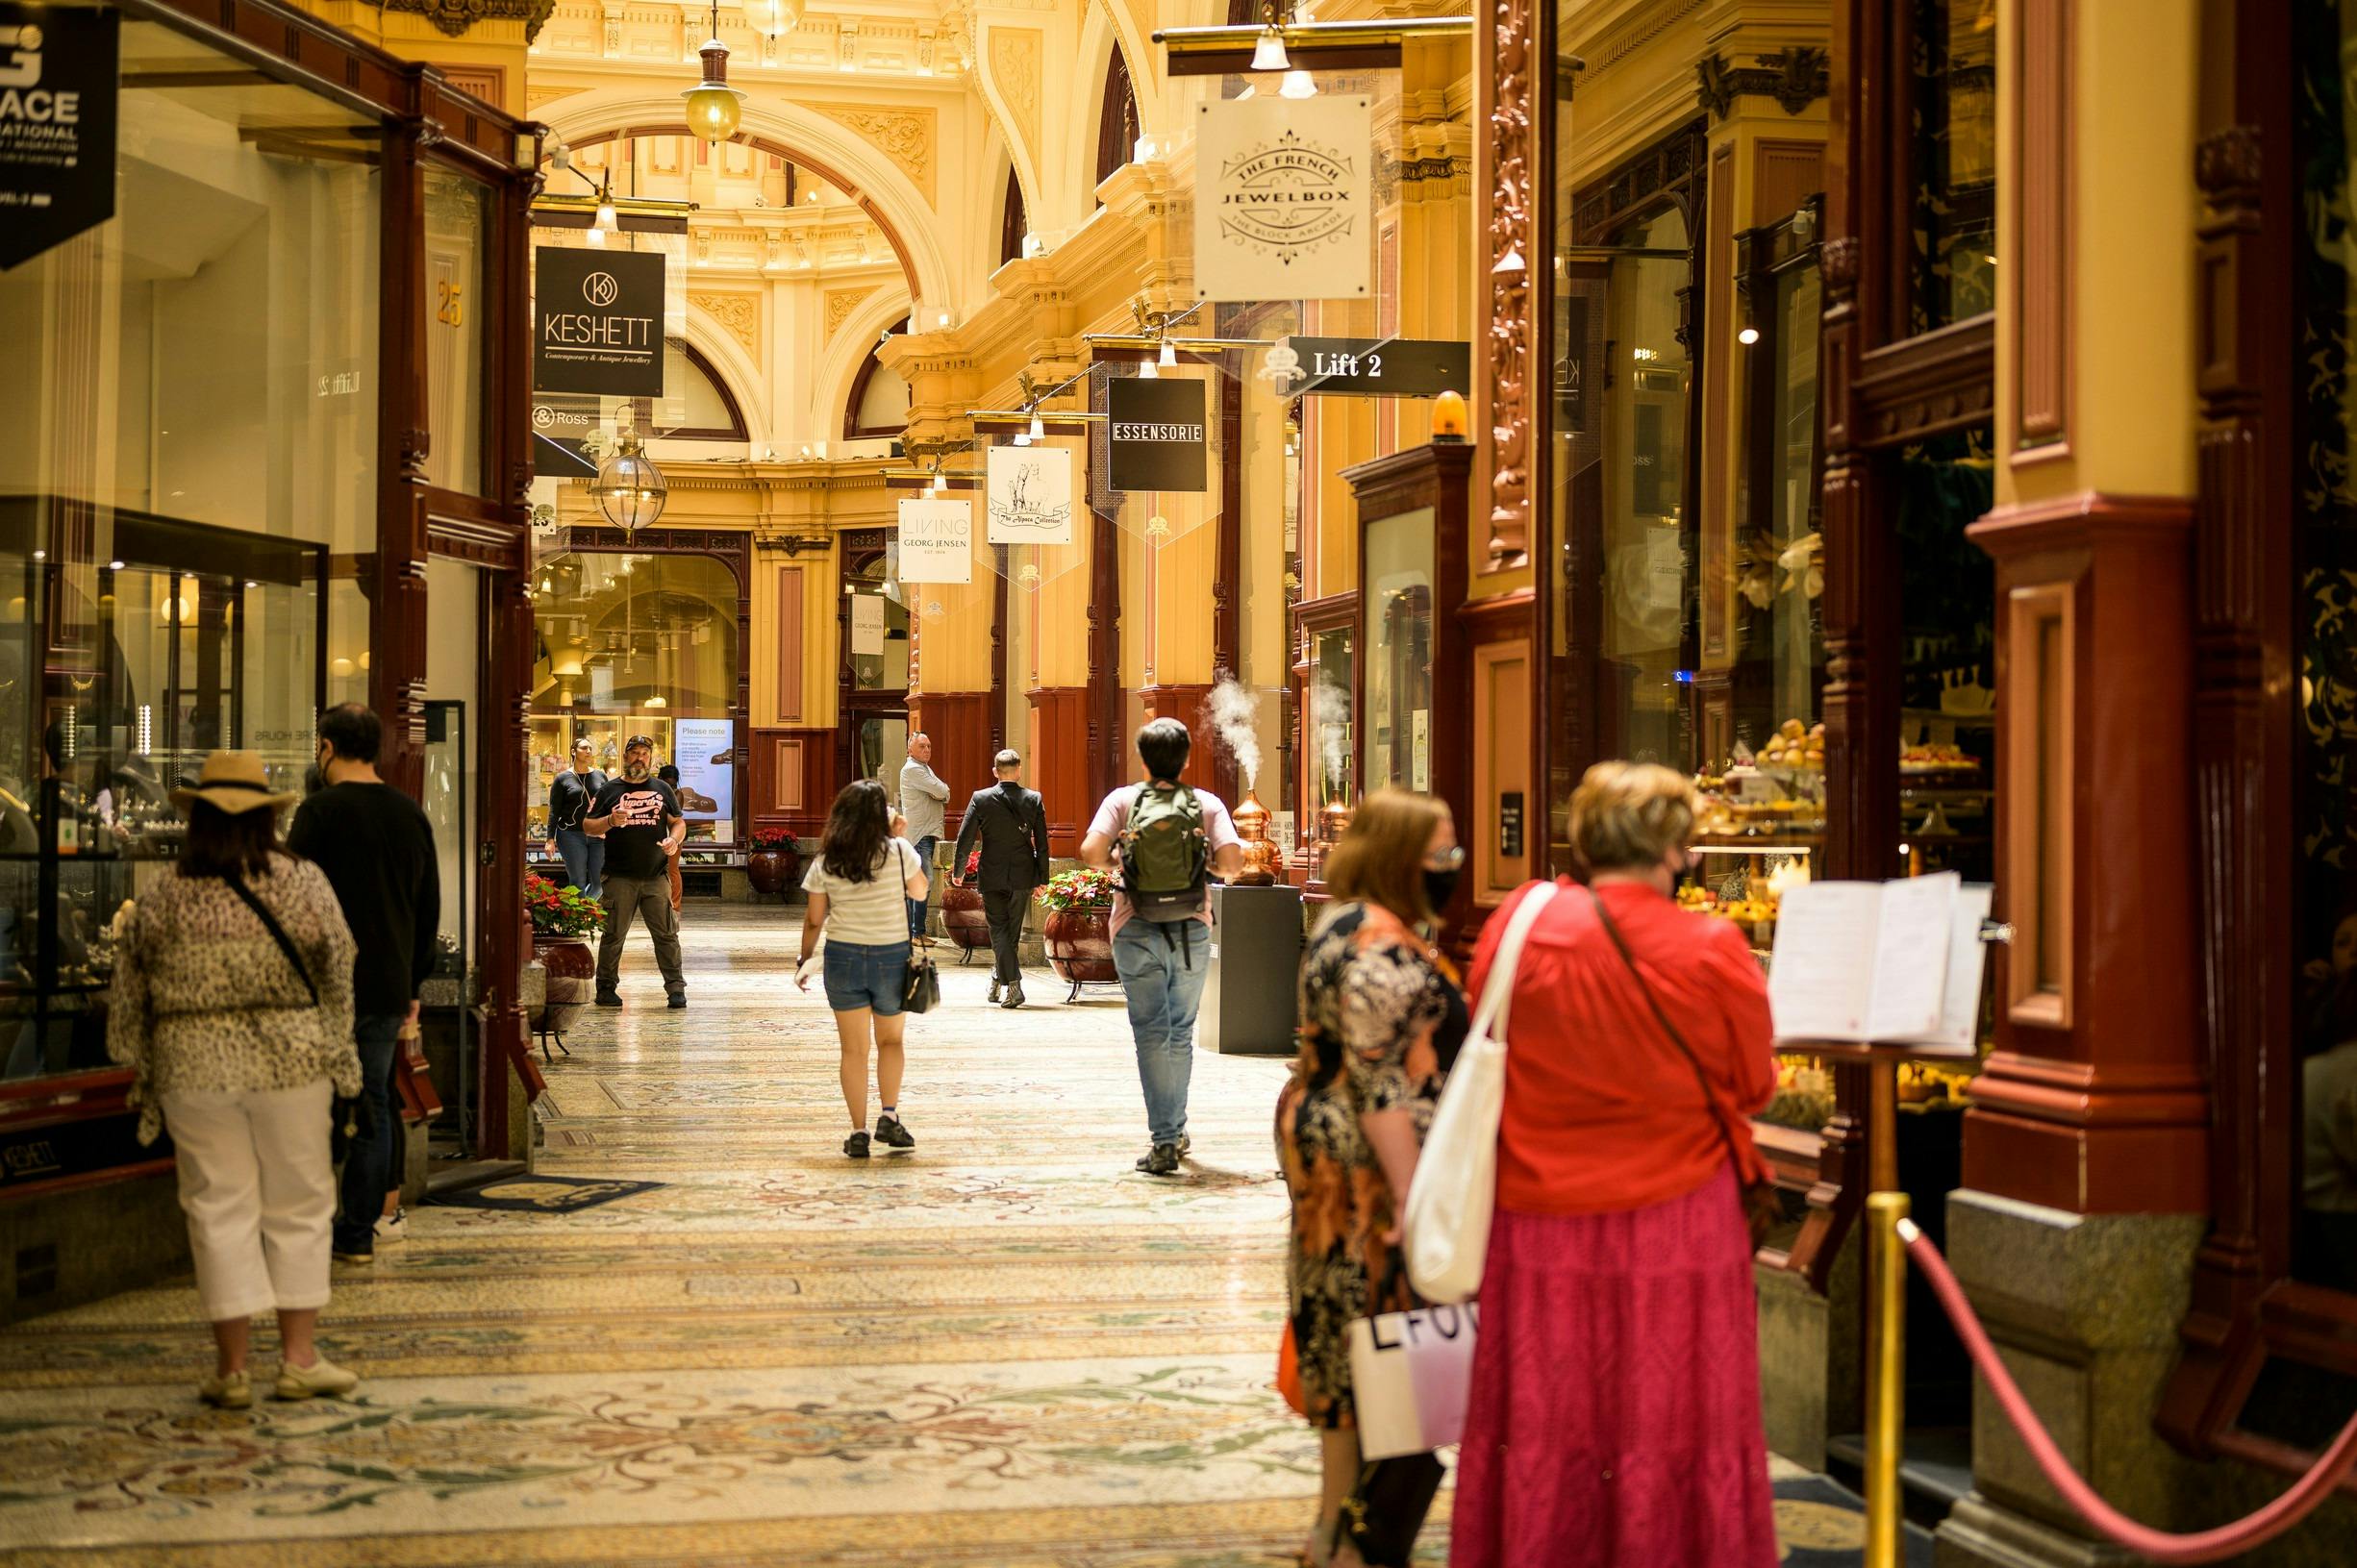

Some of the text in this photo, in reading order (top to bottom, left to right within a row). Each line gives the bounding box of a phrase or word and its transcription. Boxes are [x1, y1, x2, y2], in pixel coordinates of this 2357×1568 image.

[0, 122, 77, 139] ATIONAL
[1238, 155, 1340, 181] THE FRENCH
[1221, 191, 1350, 205] JEWELBOX
[1232, 212, 1343, 239] THE BLOCK ARCADE
[439, 281, 463, 328] 25
[545, 313, 653, 346] KESHETT
[544, 352, 589, 361] Contemporary
[597, 354, 622, 363] Antique
[622, 355, 652, 365] Jewellery
[1314, 352, 1359, 377] Lift
[1367, 354, 1381, 377] 2
[557, 411, 589, 425] Ross
[1115, 425, 1201, 440] ESSENSORIE
[903, 518, 968, 535] LIVING
[1000, 514, 1061, 525] The Alpaca Collection
[904, 538, 966, 549] GEORG JENSEN
[682, 727, 707, 735] Please
